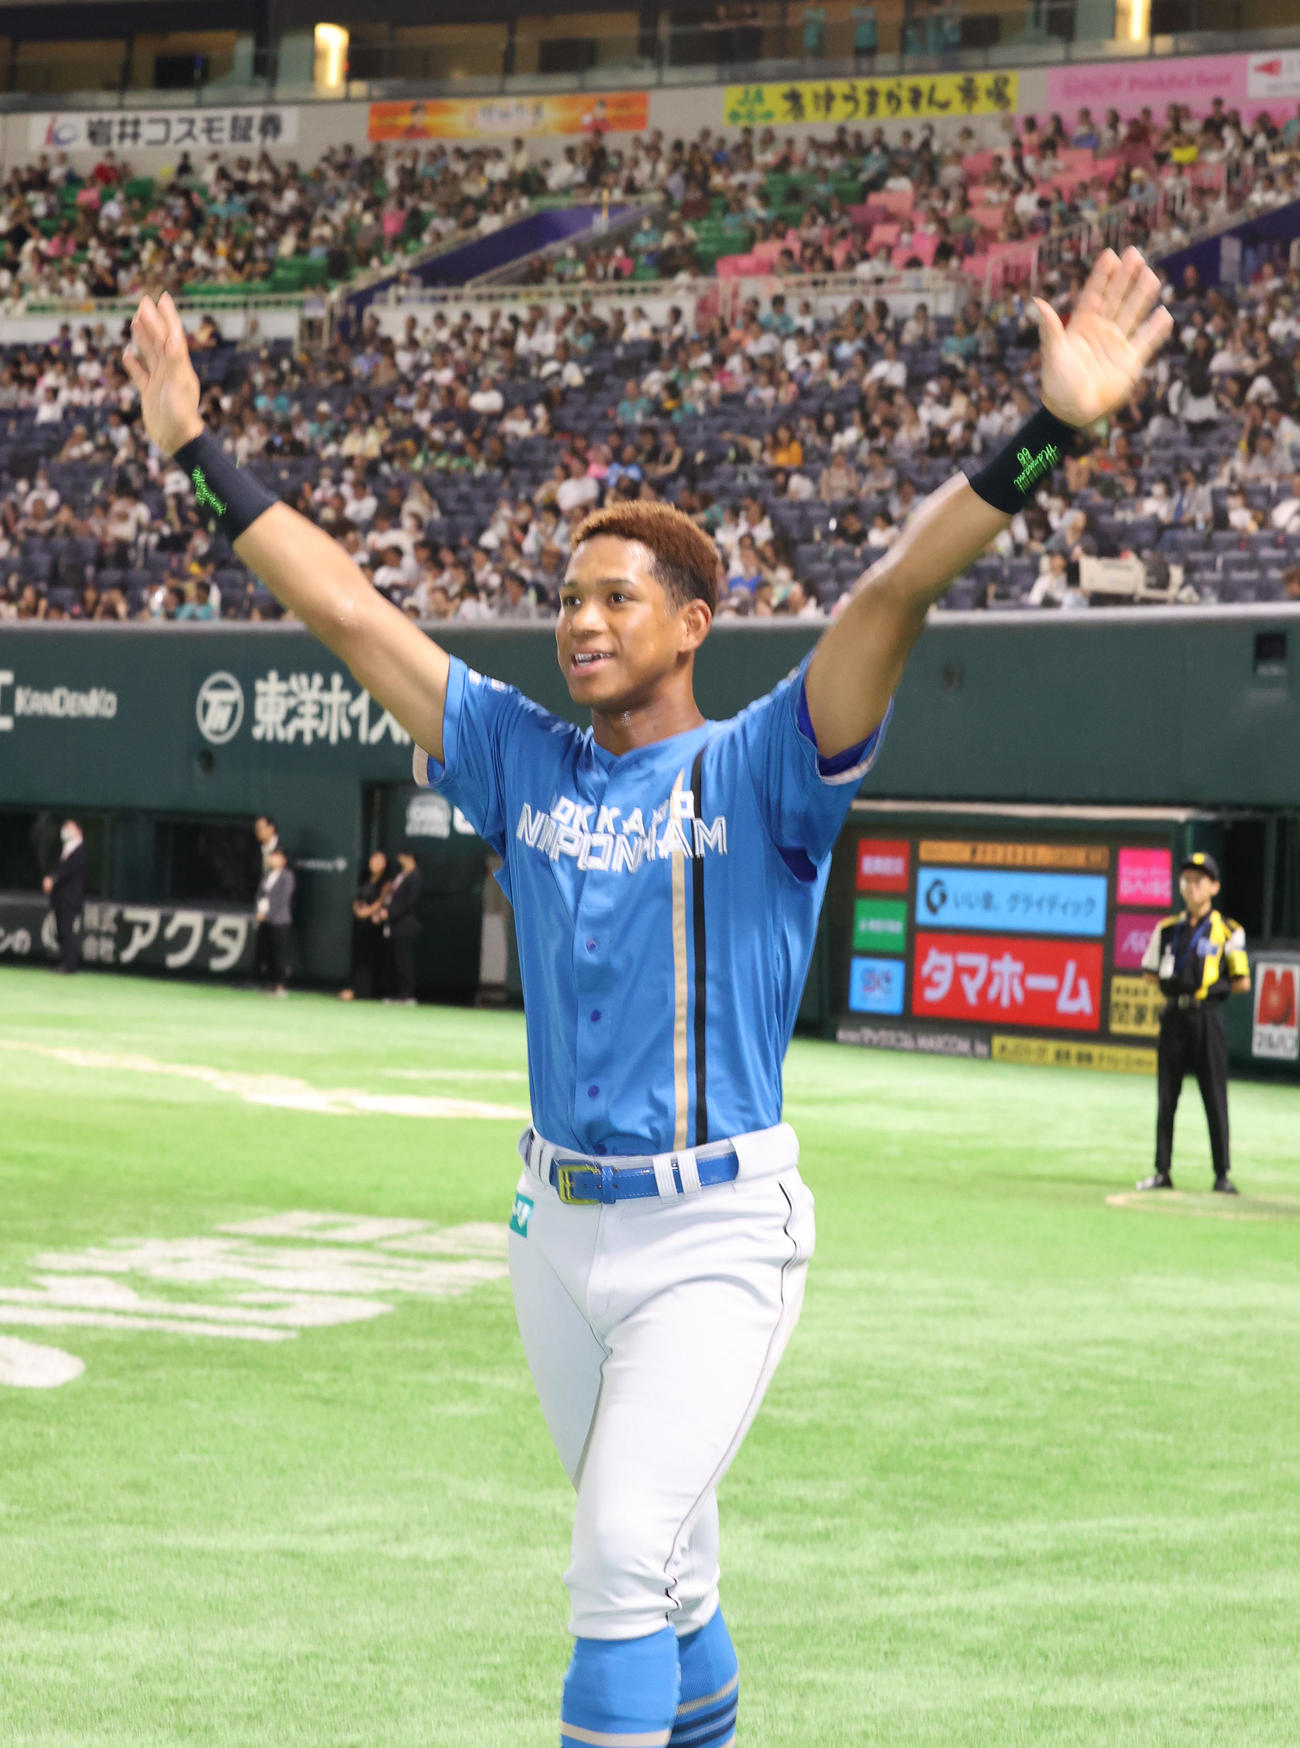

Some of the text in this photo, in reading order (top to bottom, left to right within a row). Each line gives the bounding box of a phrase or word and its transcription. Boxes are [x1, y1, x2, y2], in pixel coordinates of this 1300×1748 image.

[87, 111, 282, 147] 岩井コスモ証券
[252, 669, 411, 745] 東洋ホイ
[119, 907, 249, 972] アクタ
[921, 946, 1094, 1016] タマホーム
